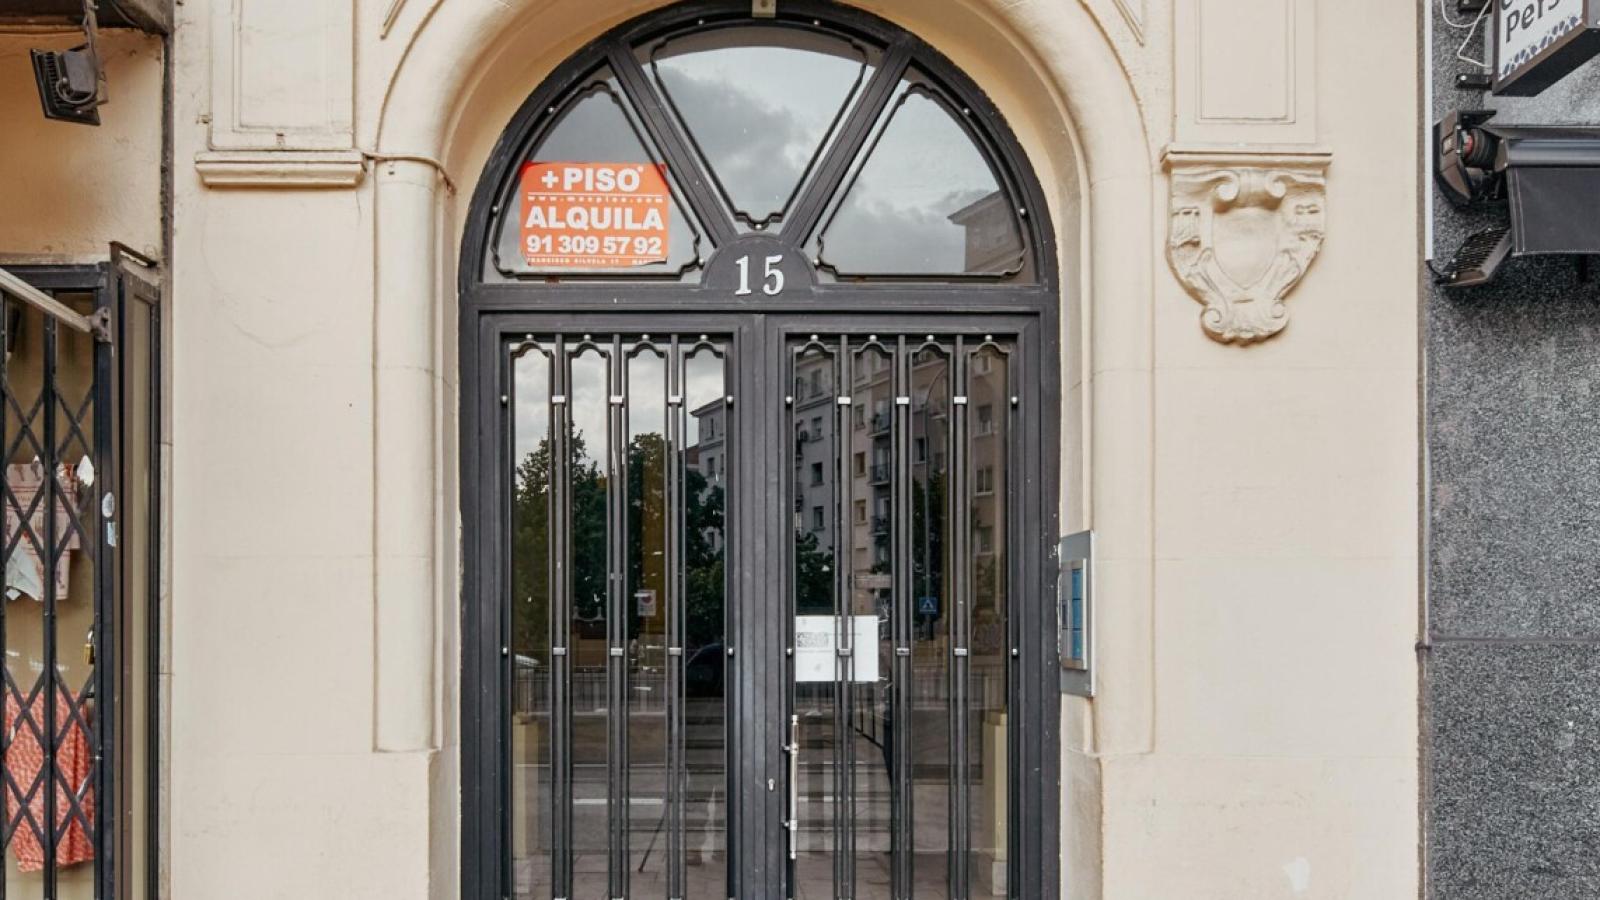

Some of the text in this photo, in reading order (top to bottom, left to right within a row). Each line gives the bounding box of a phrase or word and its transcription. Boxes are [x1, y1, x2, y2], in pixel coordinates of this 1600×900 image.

[525, 205, 664, 230] ALQUILA
[526, 235, 662, 254] 91 309 57 92
[735, 254, 784, 295] 15
